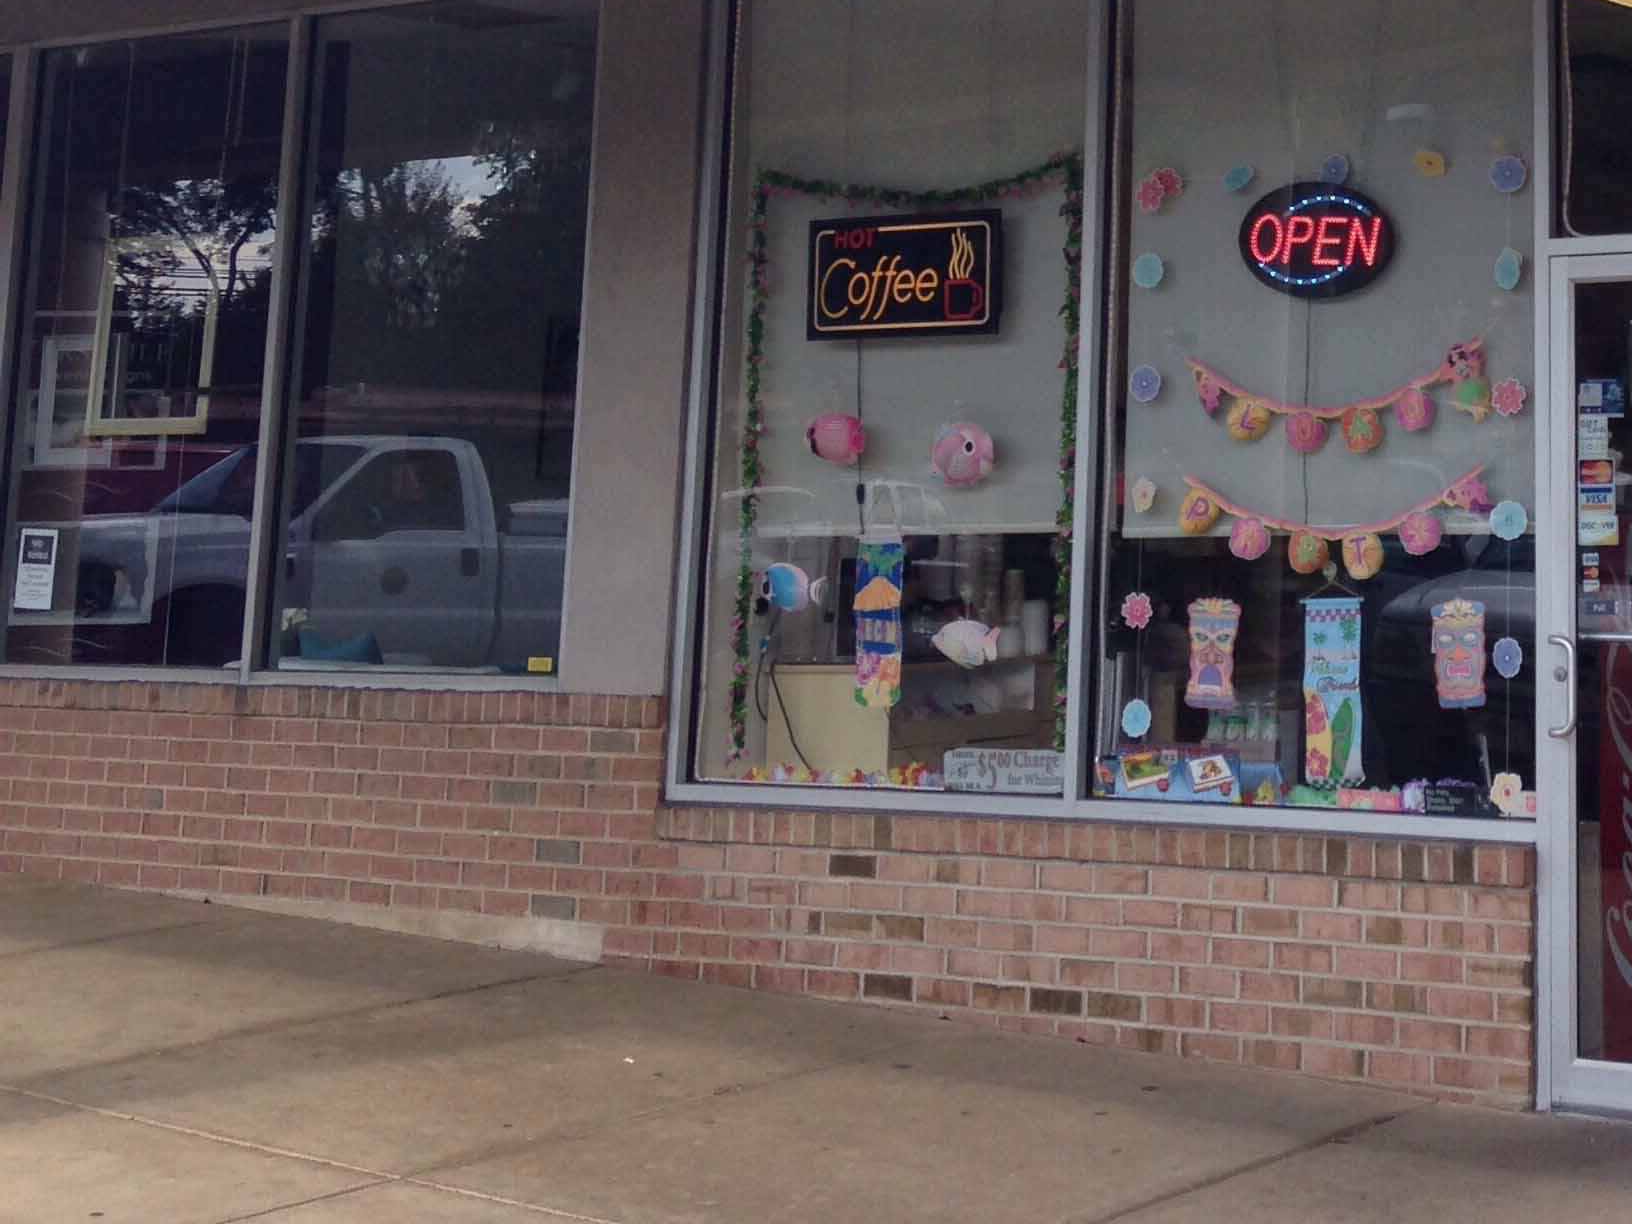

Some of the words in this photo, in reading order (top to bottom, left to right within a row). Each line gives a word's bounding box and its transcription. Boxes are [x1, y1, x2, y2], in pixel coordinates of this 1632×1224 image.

[834, 229, 876, 249] HOT
[1249, 215, 1382, 268] OPEN
[820, 255, 939, 321] Coffee
[1585, 494, 1608, 504] VISA
